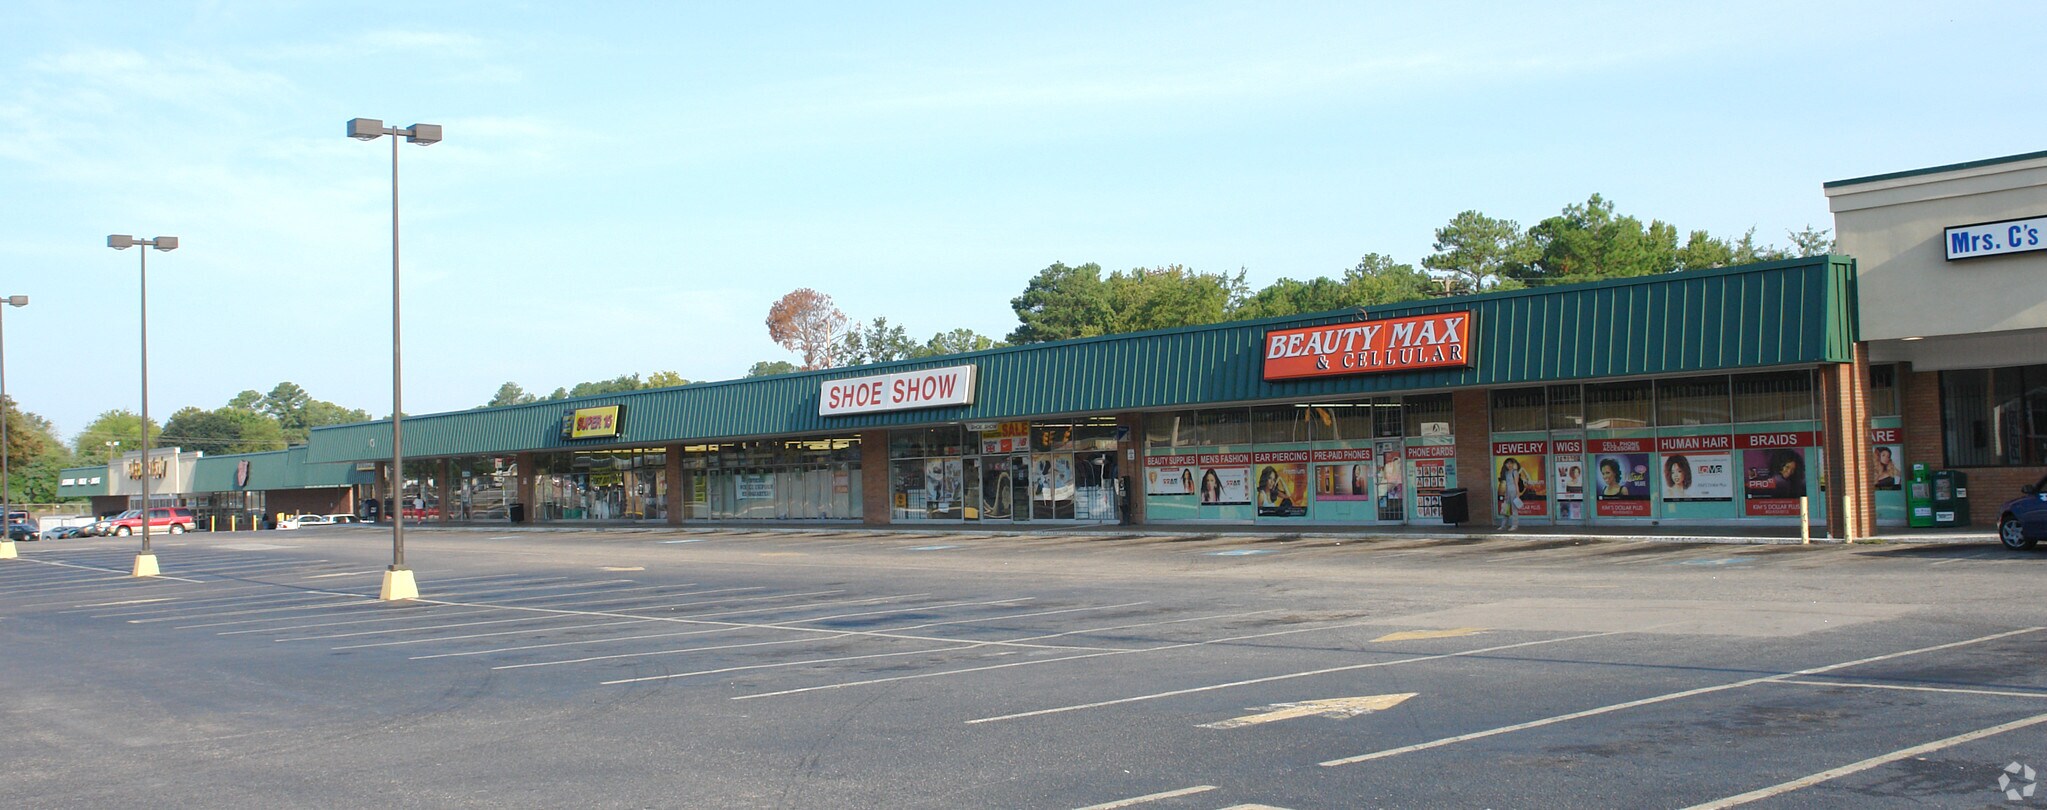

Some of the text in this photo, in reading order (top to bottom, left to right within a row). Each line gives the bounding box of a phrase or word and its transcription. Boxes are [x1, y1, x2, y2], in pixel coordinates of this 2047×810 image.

[1951, 224, 2039, 254] Mrs. C's
[1266, 317, 1465, 360] BEAUTY MAX
[1315, 344, 1462, 371] & CELLULAR
[828, 373, 957, 409] SHOE SHOW
[577, 415, 603, 431] SUPER
[1001, 421, 1028, 437] SALE
[1661, 436, 1729, 449] HUMAN HAIR
[1750, 433, 1798, 446] BRAIDS
[1408, 446, 1454, 457] PHONE CARDS
[1496, 442, 1544, 454] JEWELRY
[1556, 441, 1580, 452] WIGS
[1147, 455, 1195, 465] BEAUTY SUPPLIES
[1220, 454, 1249, 463] FASHION
[1254, 451, 1308, 462] EAR PIERCING
[1314, 449, 1370, 460] PRE-PAID PHONES
[1749, 480, 1768, 488] PRO
